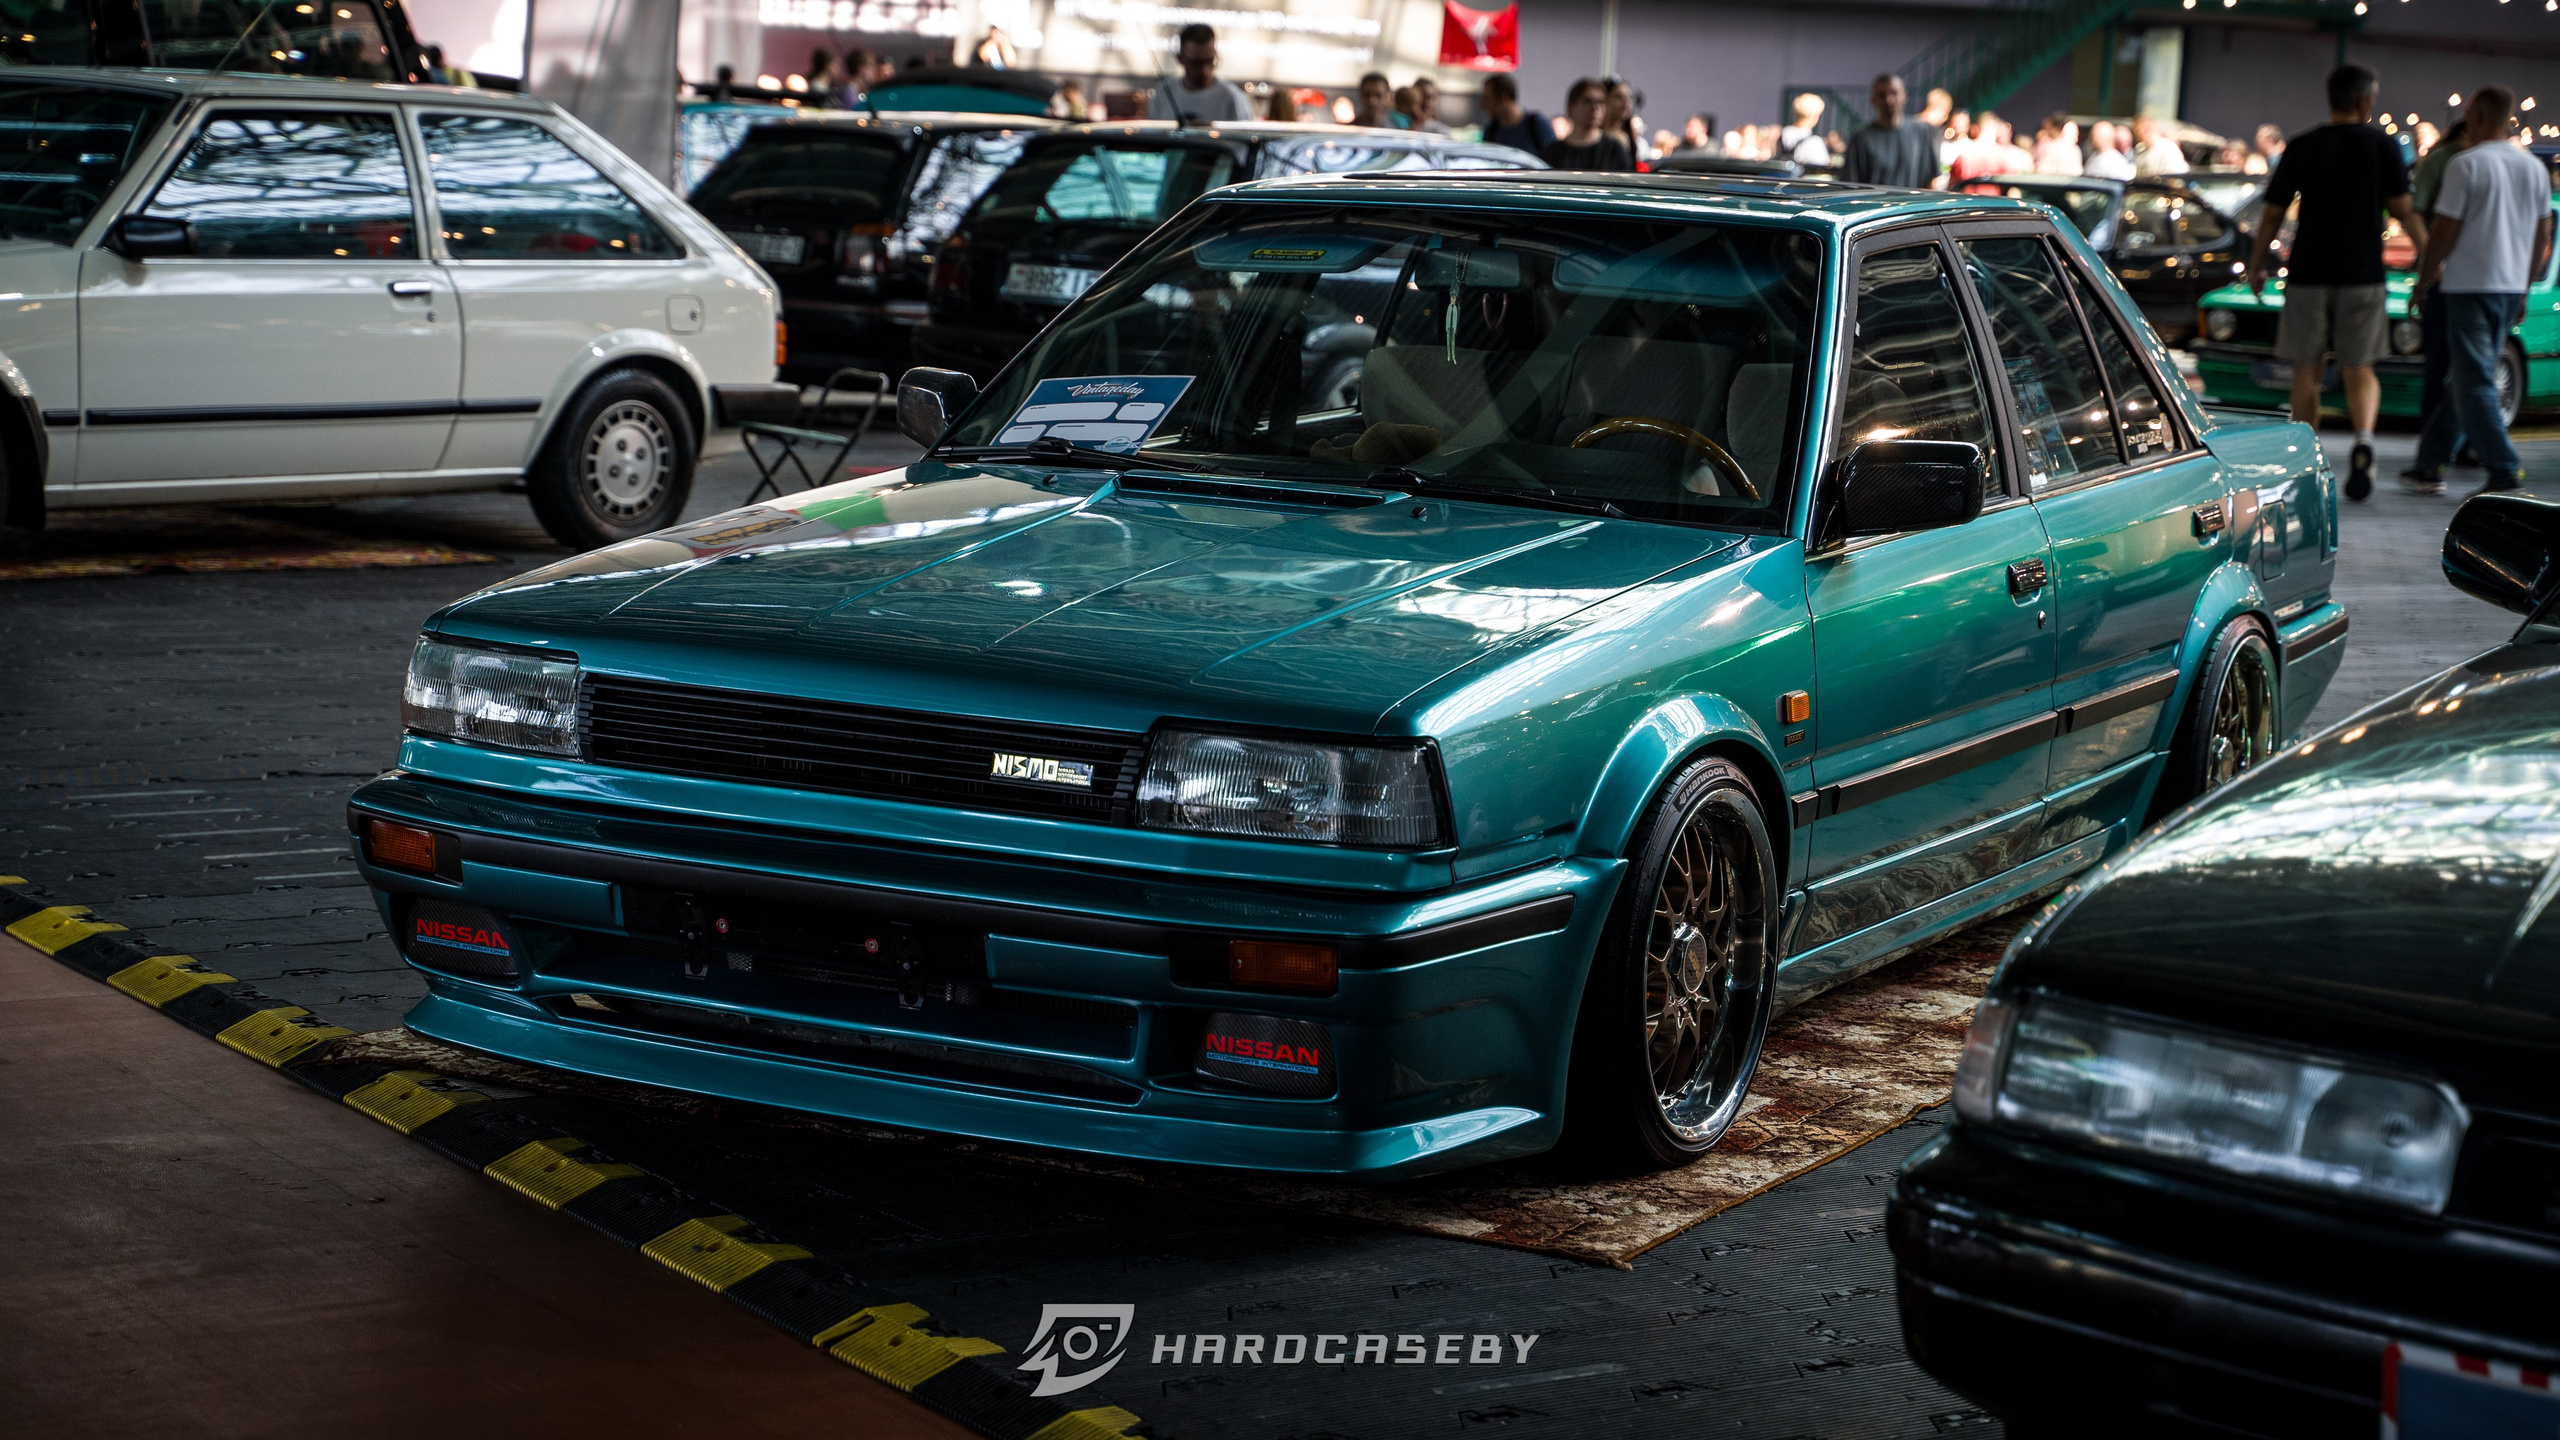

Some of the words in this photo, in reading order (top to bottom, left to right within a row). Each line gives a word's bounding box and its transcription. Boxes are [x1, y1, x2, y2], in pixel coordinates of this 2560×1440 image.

[1067, 381, 1145, 400] Vintageday
[992, 752, 1060, 782] NISMO
[416, 918, 509, 949] NISSAN
[461, 943, 508, 956] INTERNATIONAL
[1206, 1033, 1318, 1066] NISSAN
[1208, 1053, 1260, 1066] MOTORSPORTS
[1261, 1061, 1316, 1073] INTERNATIONAL
